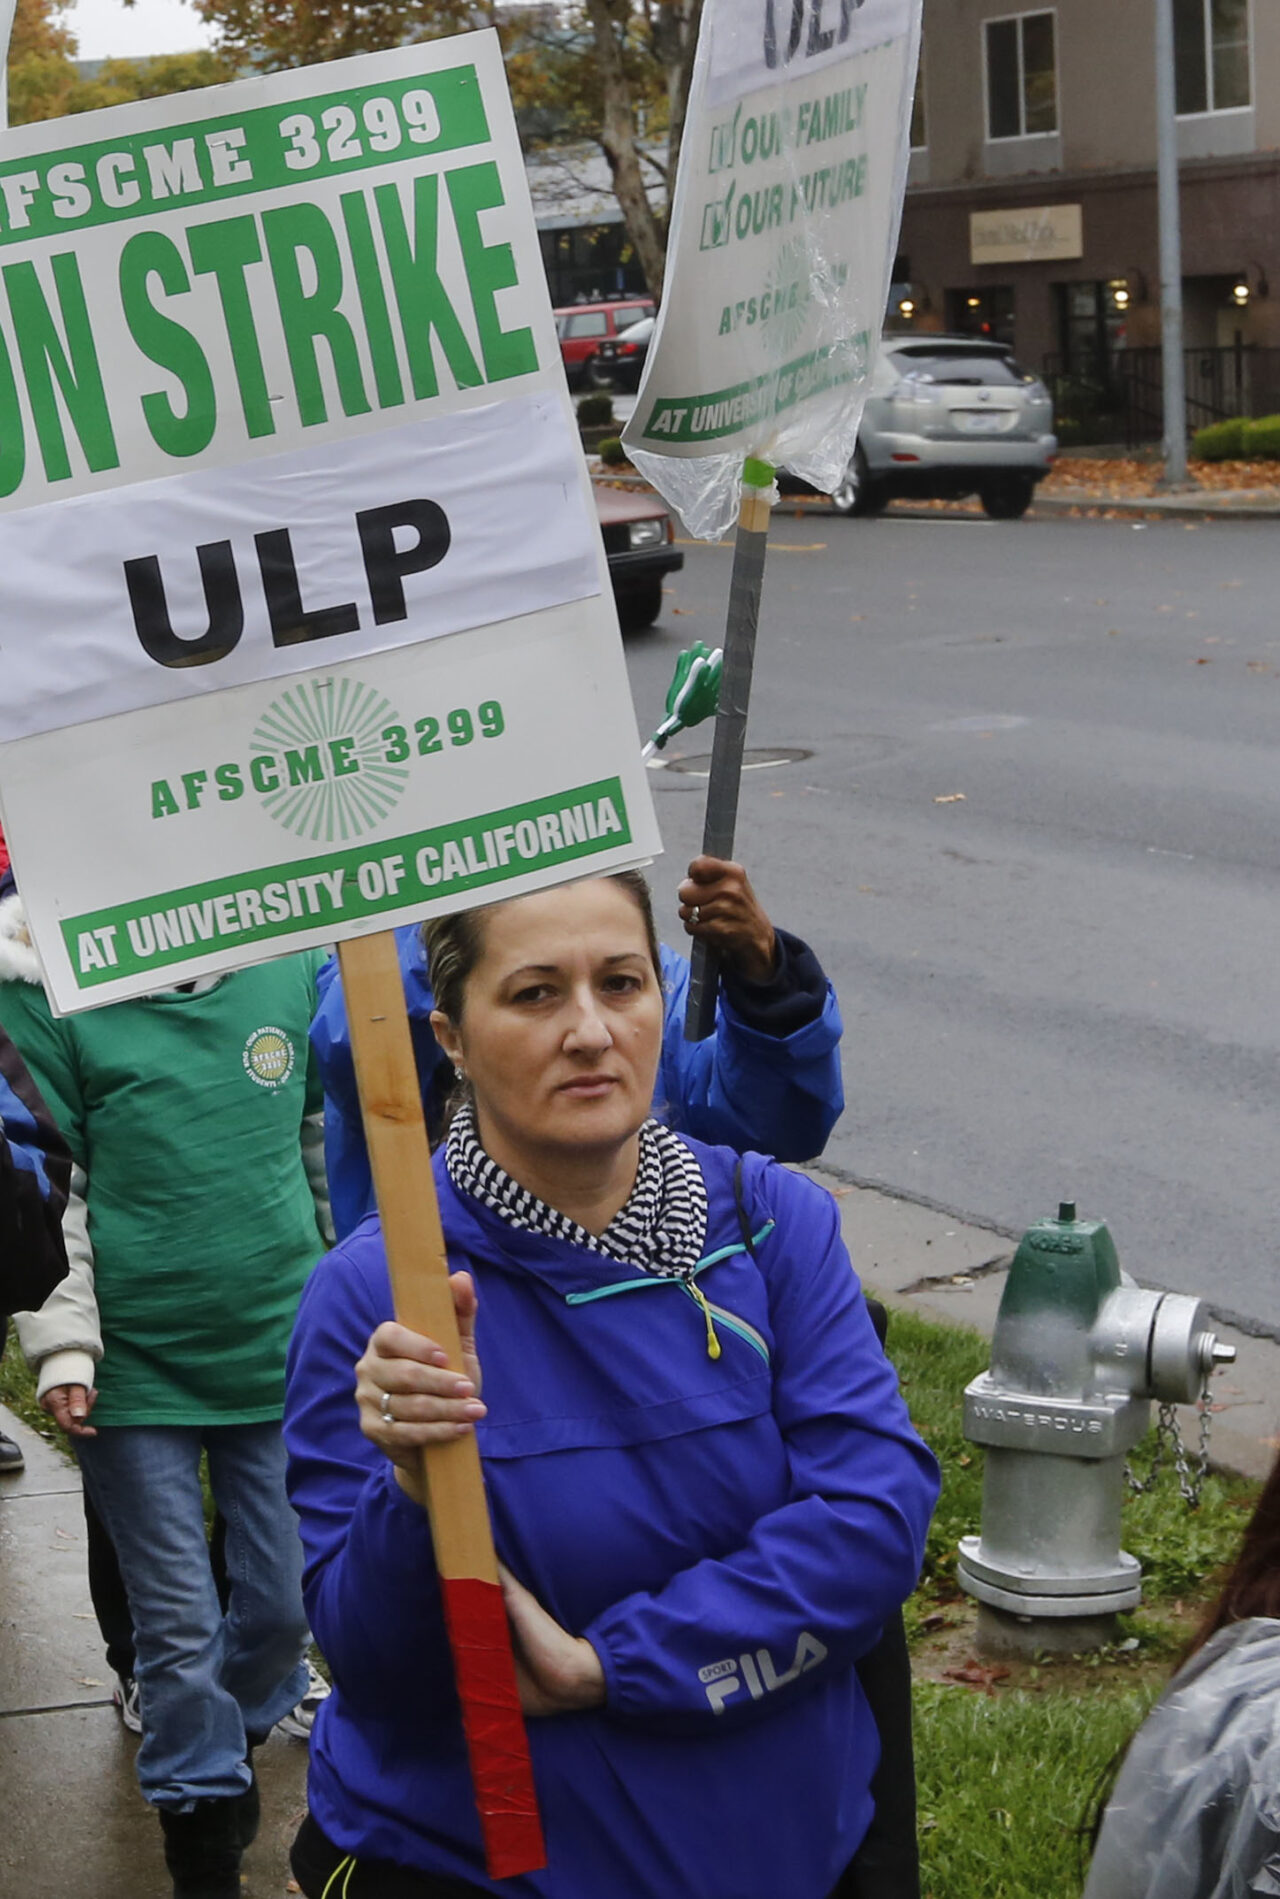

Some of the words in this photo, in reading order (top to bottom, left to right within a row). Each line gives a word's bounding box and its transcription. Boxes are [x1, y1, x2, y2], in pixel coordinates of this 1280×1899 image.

[279, 88, 442, 170] 3299
[797, 83, 868, 148] FAMILY
[735, 183, 784, 241] OUR
[119, 160, 541, 458] STRIKE
[652, 409, 687, 434] AT
[123, 498, 452, 669] ULP
[150, 737, 359, 819] AFSCME
[382, 700, 506, 764] 3299
[78, 925, 119, 974] AT
[126, 871, 350, 959] UNIVERSITY
[357, 854, 404, 900] OF
[416, 796, 622, 888] CALIFORNIA
[242, 1051, 250, 1067] OUR
[246, 1068, 276, 1087] STUDENTS
[246, 1032, 257, 1046] OUR
[257, 1026, 287, 1039] PATIENTS
[700, 1661, 734, 1681] SPORT
[705, 1631, 828, 1716] FILA
